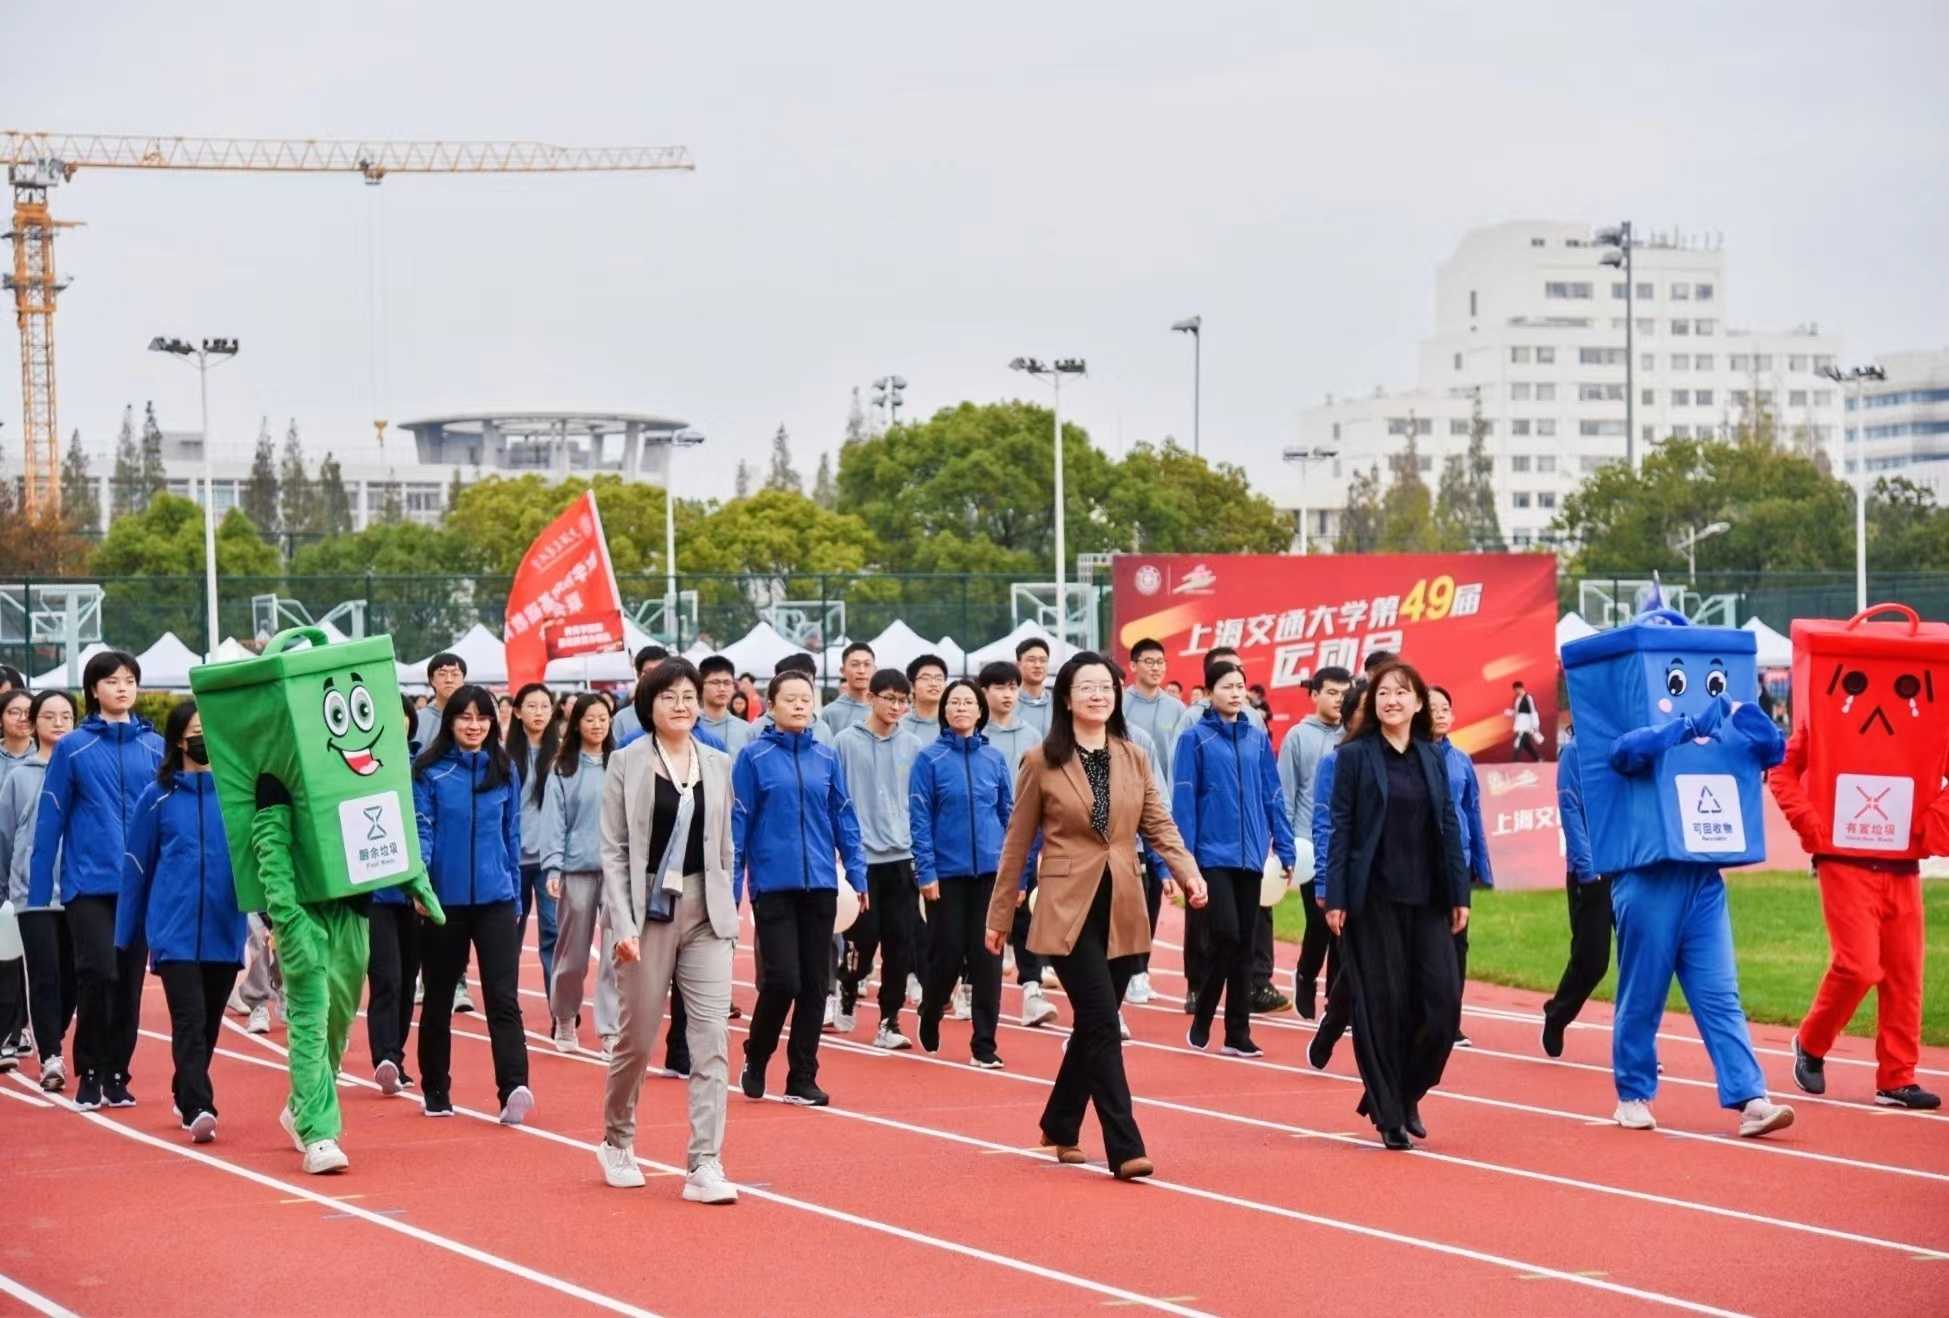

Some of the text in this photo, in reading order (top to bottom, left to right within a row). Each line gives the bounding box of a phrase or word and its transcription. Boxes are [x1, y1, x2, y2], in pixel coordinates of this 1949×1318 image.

[1178, 575, 1484, 657] 上海交通大学第49届
[1491, 806, 1562, 837] 上海交
